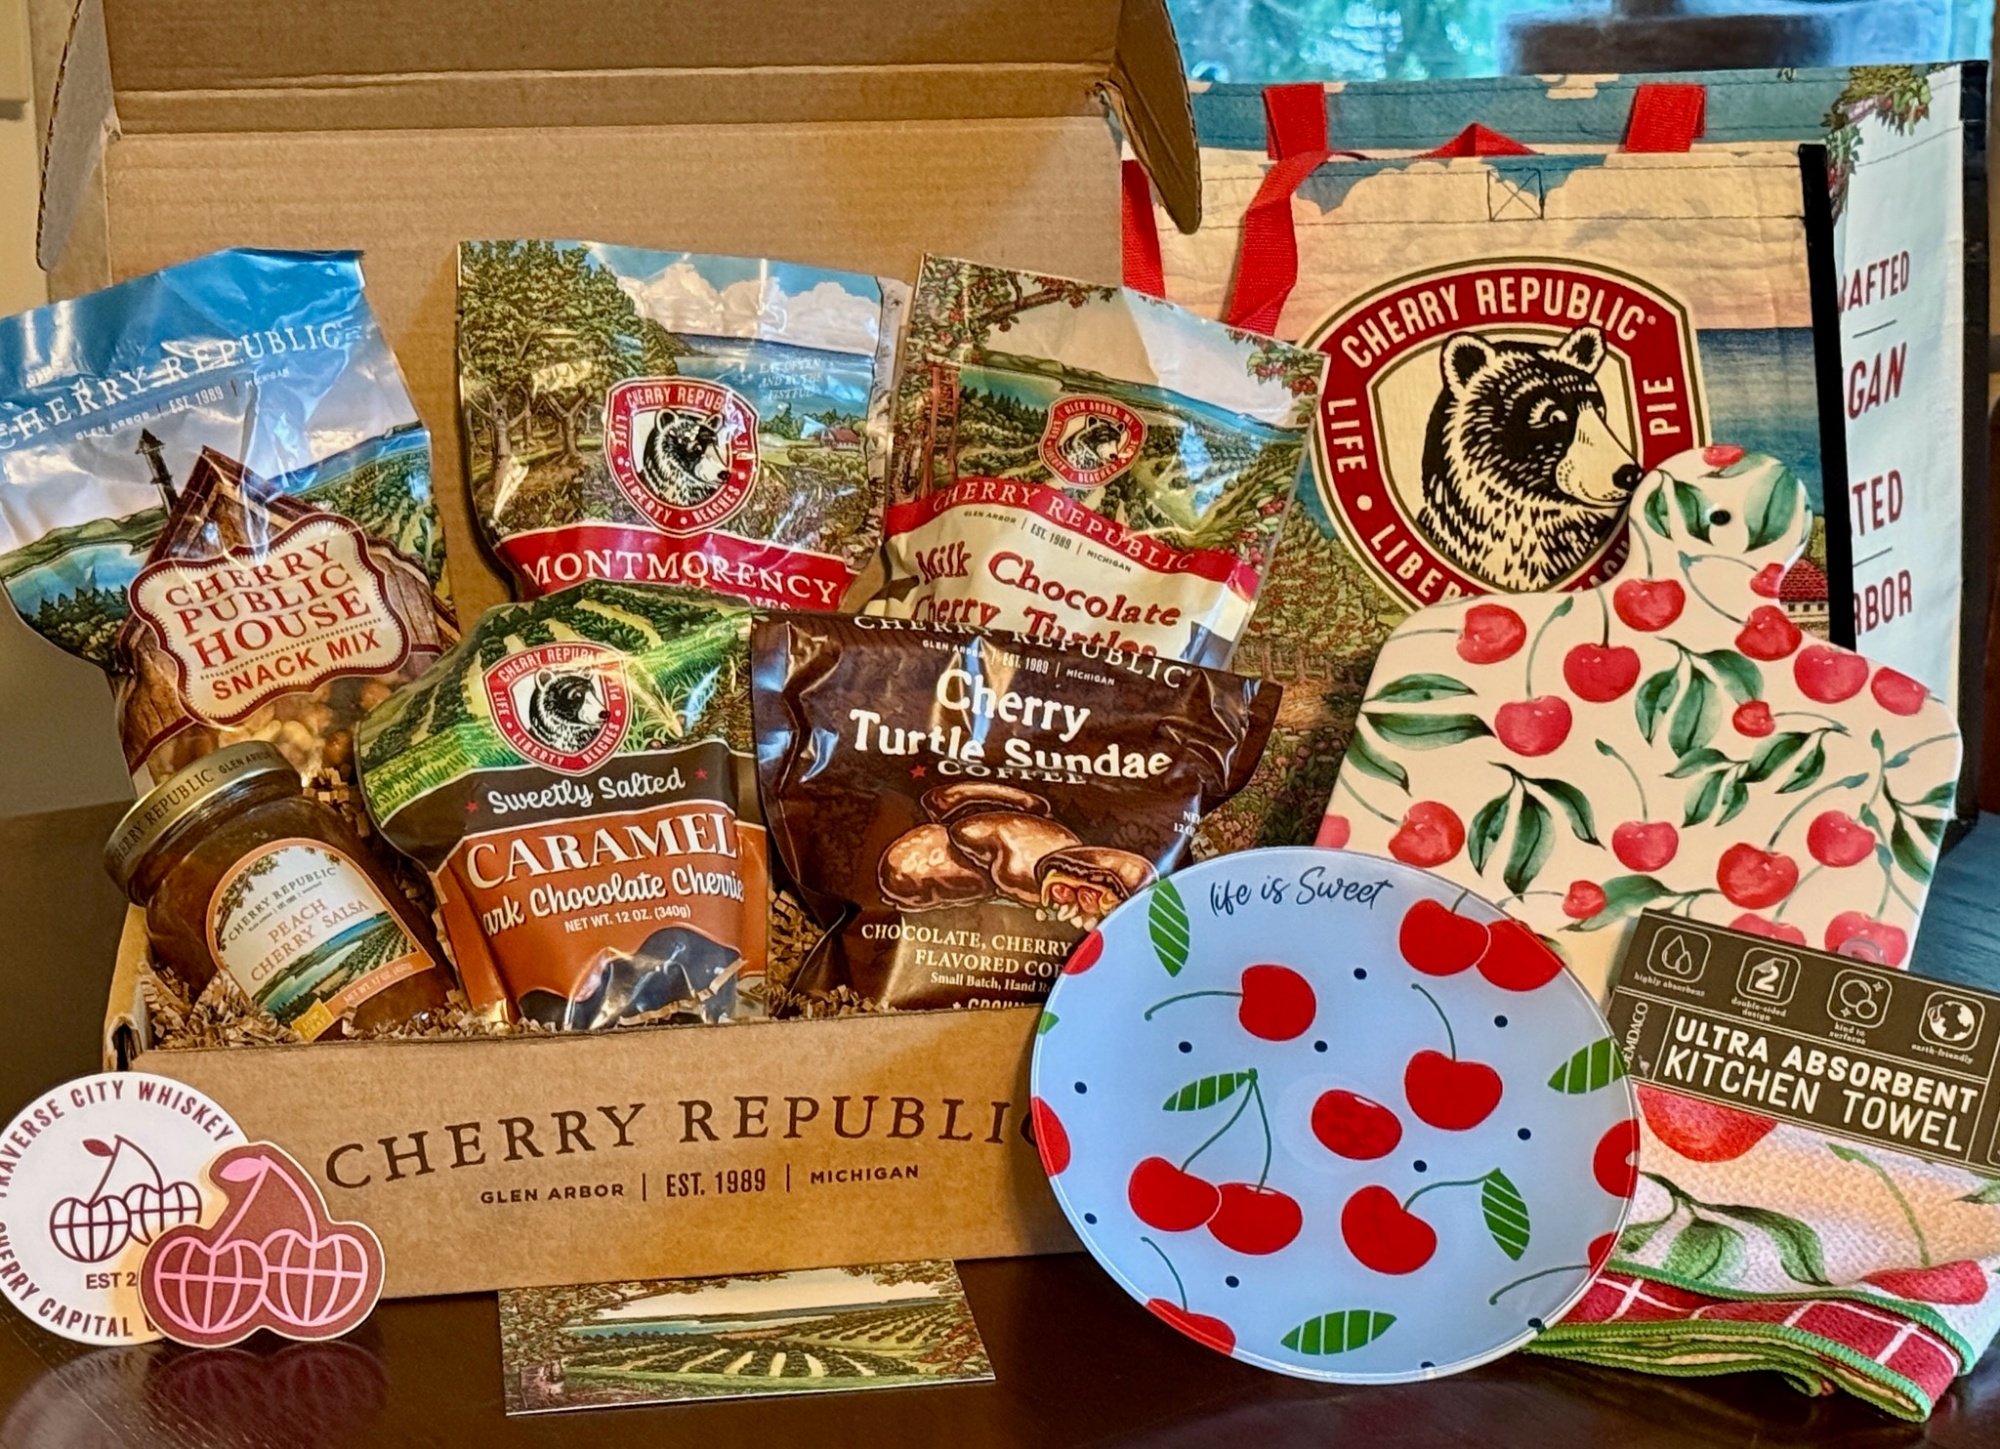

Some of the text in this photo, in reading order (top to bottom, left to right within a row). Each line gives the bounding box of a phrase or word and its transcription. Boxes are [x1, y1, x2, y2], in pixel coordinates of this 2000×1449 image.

[161, 322, 342, 381] REPUBLIC
[1341, 276, 1645, 369] CHERRY REPUBLIC
[1643, 376, 1681, 437] PIE
[1848, 341, 1907, 420] GAN
[613, 414, 628, 449] LIFE
[1328, 397, 1369, 474] LIFE
[932, 479, 1197, 571] CHERRY REPUBLIC
[1852, 468, 1904, 537] TED
[165, 538, 335, 608] CHERRY
[521, 549, 837, 606] MONTMORENCY
[915, 540, 1182, 629] Milk Chocolate
[1049, 531, 1072, 551] 1989
[1086, 549, 1132, 573] MICHIGAN
[1370, 523, 1474, 600] LIBER
[175, 563, 357, 637] PUBLIC
[188, 588, 371, 670] HOUSE
[1854, 568, 1913, 637] RBOR
[212, 627, 381, 701] SNACK MIX
[497, 651, 542, 683] CHERRY
[922, 639, 949, 651] GLEN
[1025, 657, 1049, 675] 1989
[1066, 669, 1115, 687] MICHIGAN
[493, 690, 511, 717] LIFE
[935, 667, 1092, 743] Cherry
[512, 731, 566, 766] LIBERTY
[581, 721, 621, 765] BEACHES
[848, 708, 1174, 781] Turtle Sundae
[112, 820, 146, 864] HERRY
[144, 769, 214, 828] REPUBLIC
[218, 759, 245, 775] GLEN
[487, 766, 686, 815] Sweetly Salted
[466, 812, 739, 890] CARAMEL
[228, 896, 271, 942] CHERRY
[272, 866, 337, 900] REPUBLIC
[267, 897, 329, 944] PEACH
[482, 863, 744, 937] ark Chocolate Cherrie
[564, 917, 590, 934] NET
[615, 911, 631, 925] 12
[1210, 866, 1394, 917] life is Sweet
[250, 924, 316, 982] CHERRY
[322, 899, 370, 929] SALSA
[861, 924, 1073, 957] CHOCOLATE, CHERRY
[915, 948, 1064, 979] FLAVORED COF
[930, 971, 964, 986] Small
[1004, 978, 1036, 993] Hand
[1663, 1044, 1962, 1152] KITCHEN TOWEL
[1675, 1016, 1979, 1115] ULTRA ABSORBENT
[0, 1079, 234, 1198] RAVERSE CITY WHISKEY
[325, 1102, 646, 1190] CHERRY
[480, 1163, 919, 1205] GLEN ARBOR EST. 1989 MICHIGAN
[85, 1271, 122, 1290] EST
[38, 1297, 134, 1338] CAPITAL
